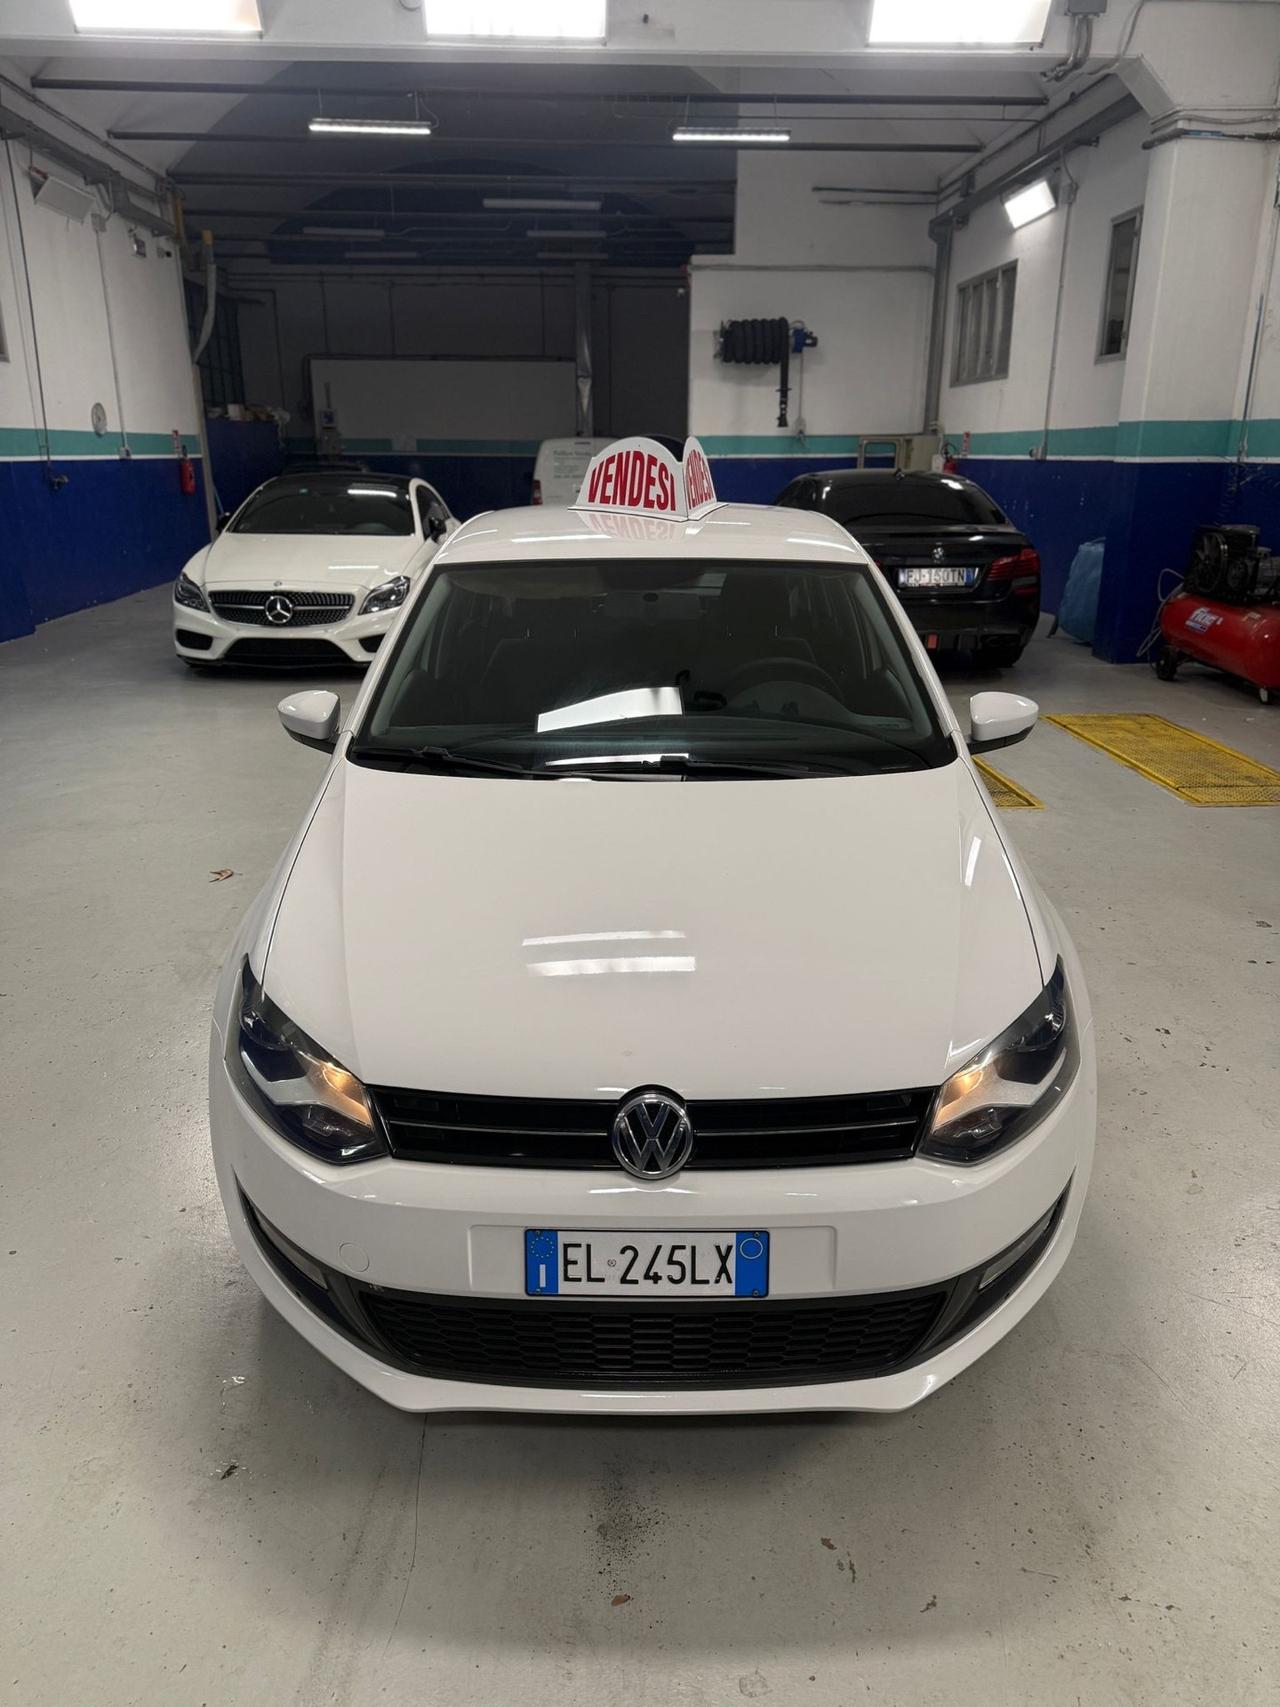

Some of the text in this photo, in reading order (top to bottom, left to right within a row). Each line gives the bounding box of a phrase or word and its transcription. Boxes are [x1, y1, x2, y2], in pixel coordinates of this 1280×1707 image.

[588, 450, 676, 511] VENDESI
[687, 449, 714, 510] VENDESI
[618, 1098, 687, 1173] VW
[563, 1243, 605, 1282] EL
[620, 1244, 733, 1285] 245LX
